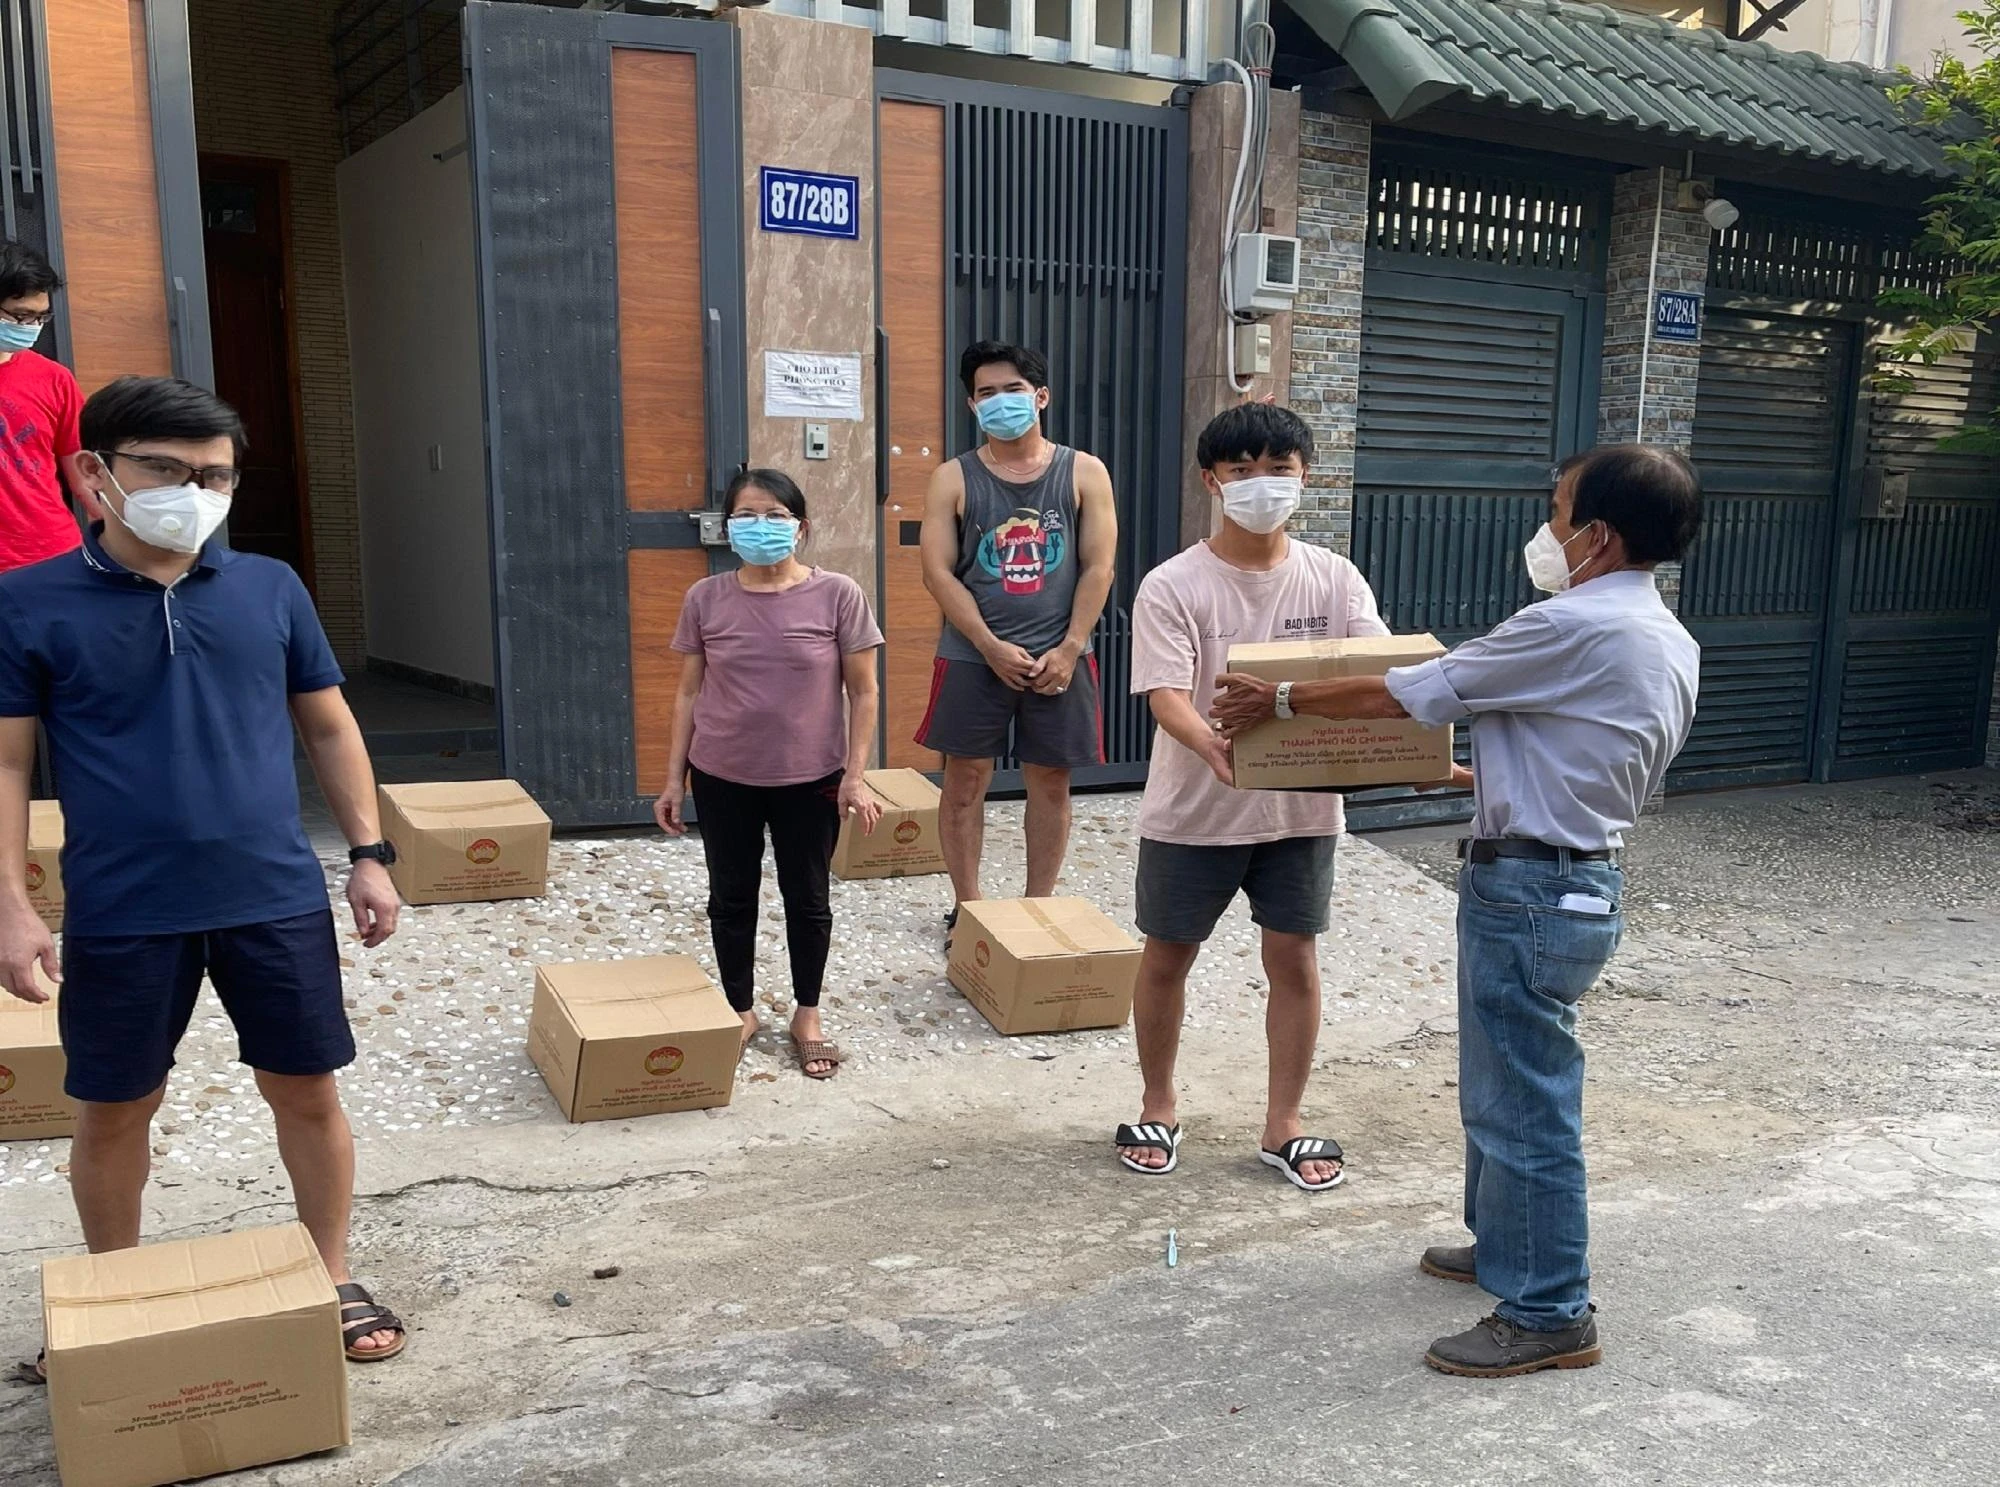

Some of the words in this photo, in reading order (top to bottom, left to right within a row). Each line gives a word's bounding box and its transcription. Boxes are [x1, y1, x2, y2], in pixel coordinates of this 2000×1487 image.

[771, 181, 849, 225] 87/28B
[1658, 296, 1697, 324] 87/28A
[1284, 618, 1302, 630] BAD
